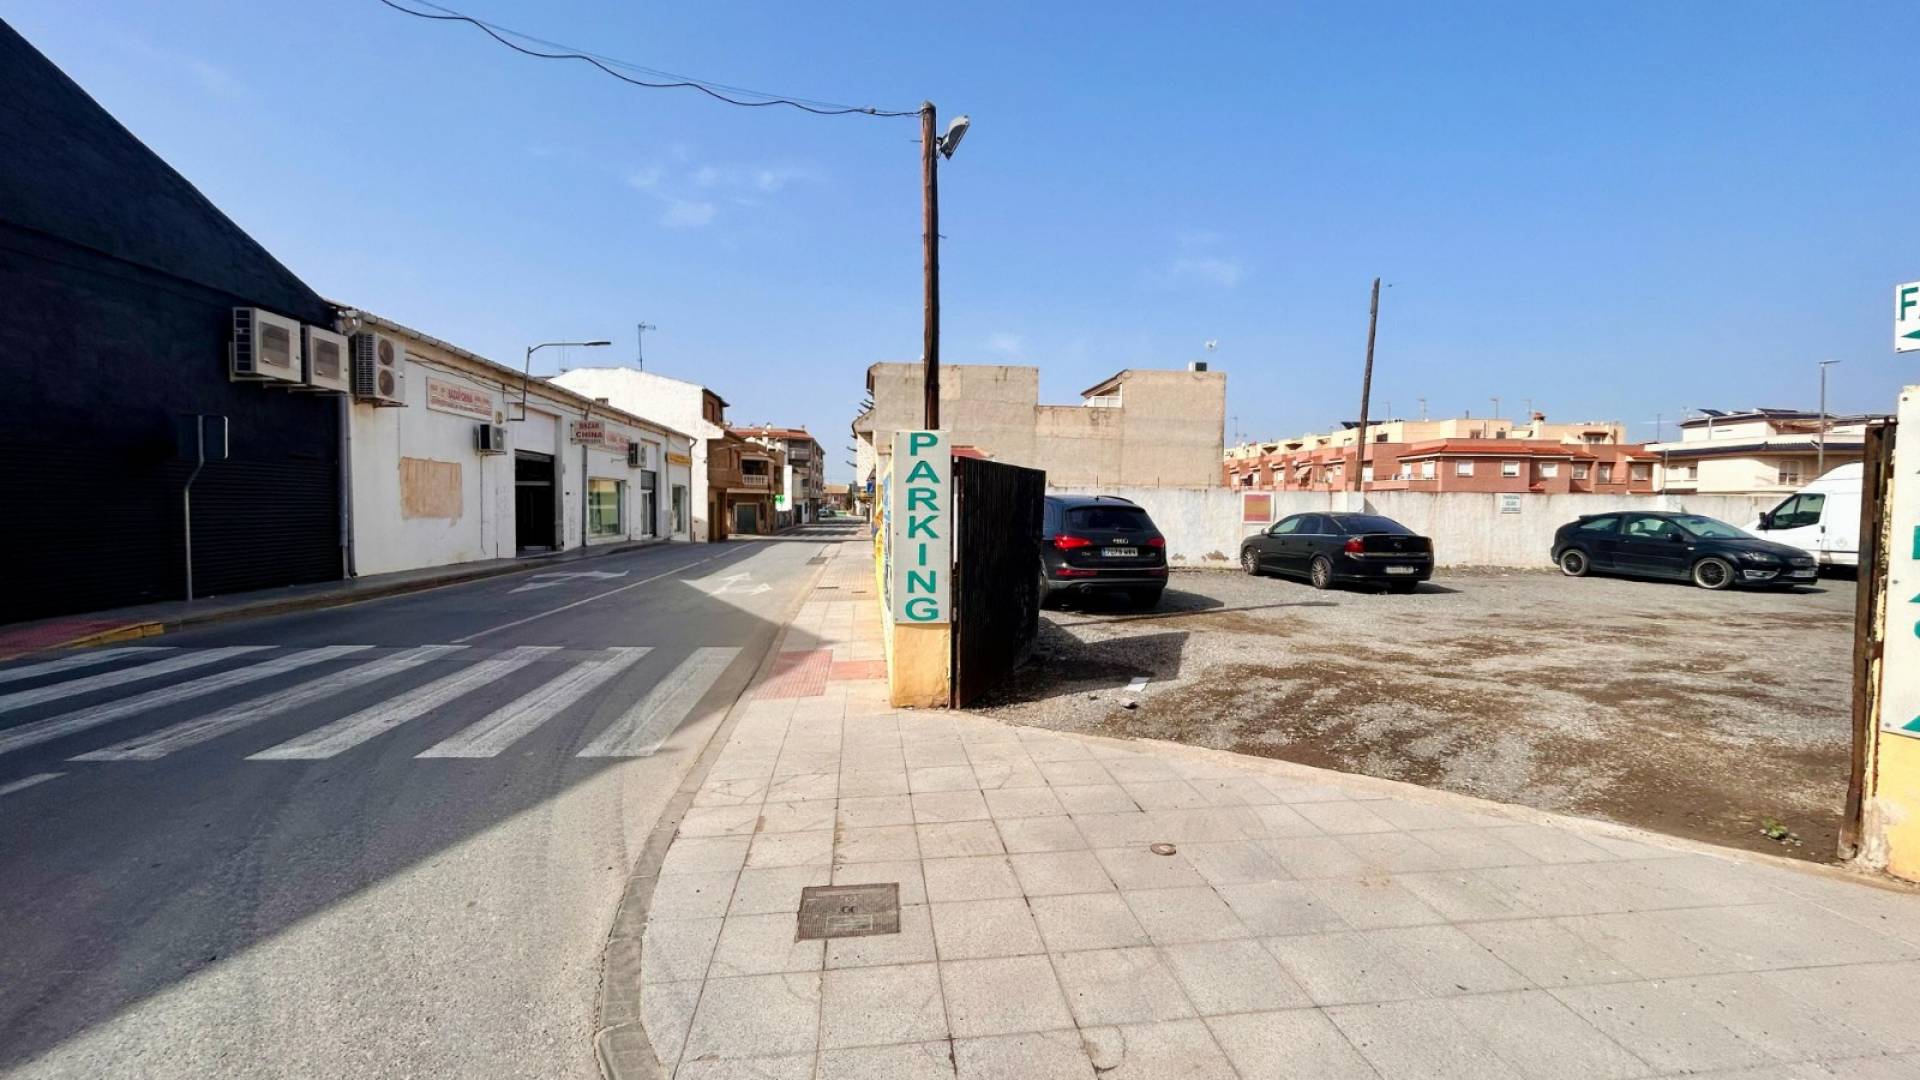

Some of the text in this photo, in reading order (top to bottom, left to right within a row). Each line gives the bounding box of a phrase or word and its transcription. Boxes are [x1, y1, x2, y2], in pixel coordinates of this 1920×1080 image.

[1901, 286, 1920, 321] F
[576, 431, 604, 439] CHINA
[578, 422, 600, 430] BAZAR
[905, 432, 941, 622] PARKING
